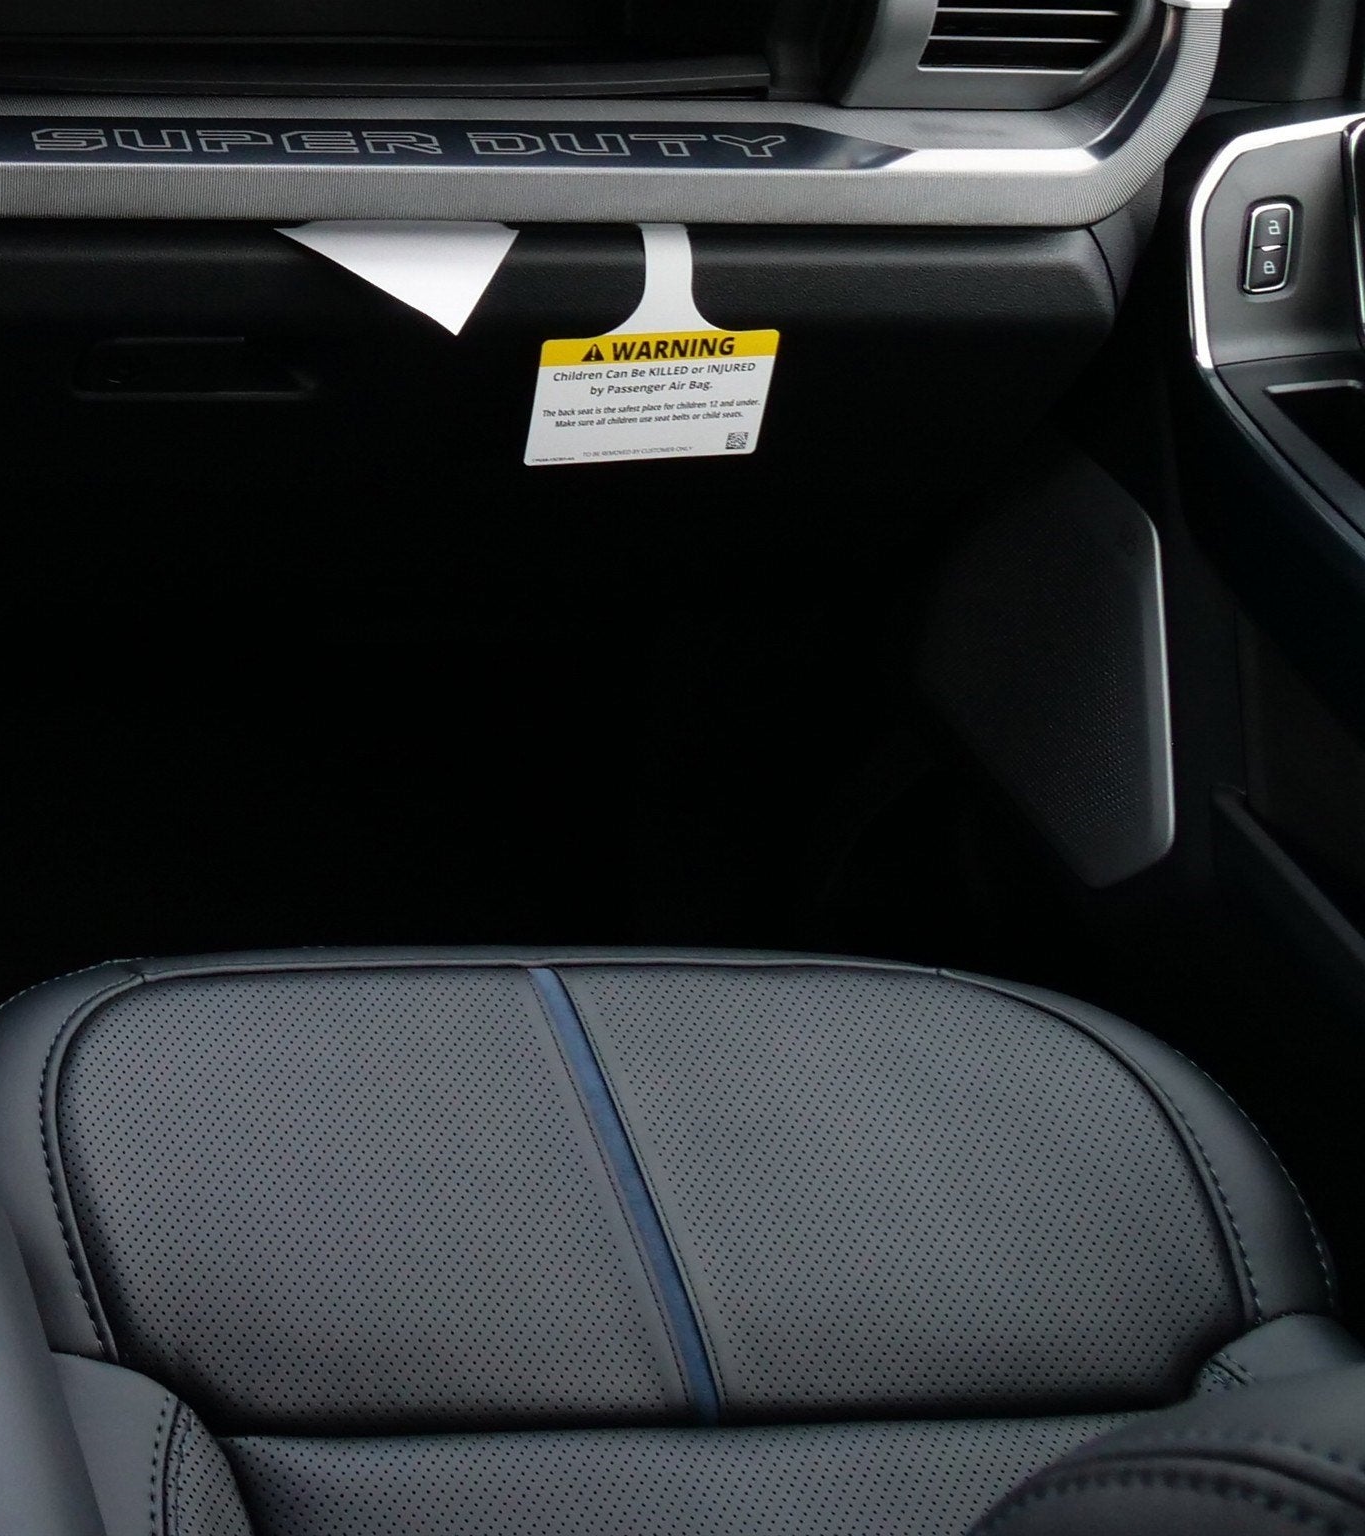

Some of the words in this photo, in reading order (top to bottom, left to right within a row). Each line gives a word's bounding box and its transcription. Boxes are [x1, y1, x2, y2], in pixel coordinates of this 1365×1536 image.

[31, 128, 445, 156] SUPER
[467, 130, 787, 158] DUTY
[612, 337, 735, 361] WARNING
[553, 371, 603, 382] Children
[606, 369, 628, 380] Can
[631, 368, 646, 378] Be
[648, 366, 689, 377] KILLED
[691, 366, 704, 375] or
[707, 362, 755, 375] INJURED
[590, 385, 604, 396] by
[607, 382, 665, 395] Passenger
[668, 380, 685, 391] Air
[688, 380, 713, 392] Bag.
[542, 409, 557, 418] The
[558, 408, 576, 417] back
[577, 407, 594, 416] seat
[595, 407, 602, 415] is
[603, 406, 616, 414] the
[617, 404, 640, 413] safest
[641, 403, 662, 413] place
[663, 402, 675, 411] for
[676, 400, 707, 410] children
[709, 400, 718, 408] 12
[719, 399, 735, 408] and
[736, 398, 761, 408] under.
[555, 419, 576, 428] Make
[577, 419, 594, 427] sure
[595, 417, 606, 426] all
[607, 415, 638, 425] children
[639, 415, 653, 424] use
[654, 414, 670, 423] seat
[671, 412, 690, 422] belts
[691, 412, 701, 420] or
[702, 410, 721, 420] child
[721, 410, 744, 419] seats.
